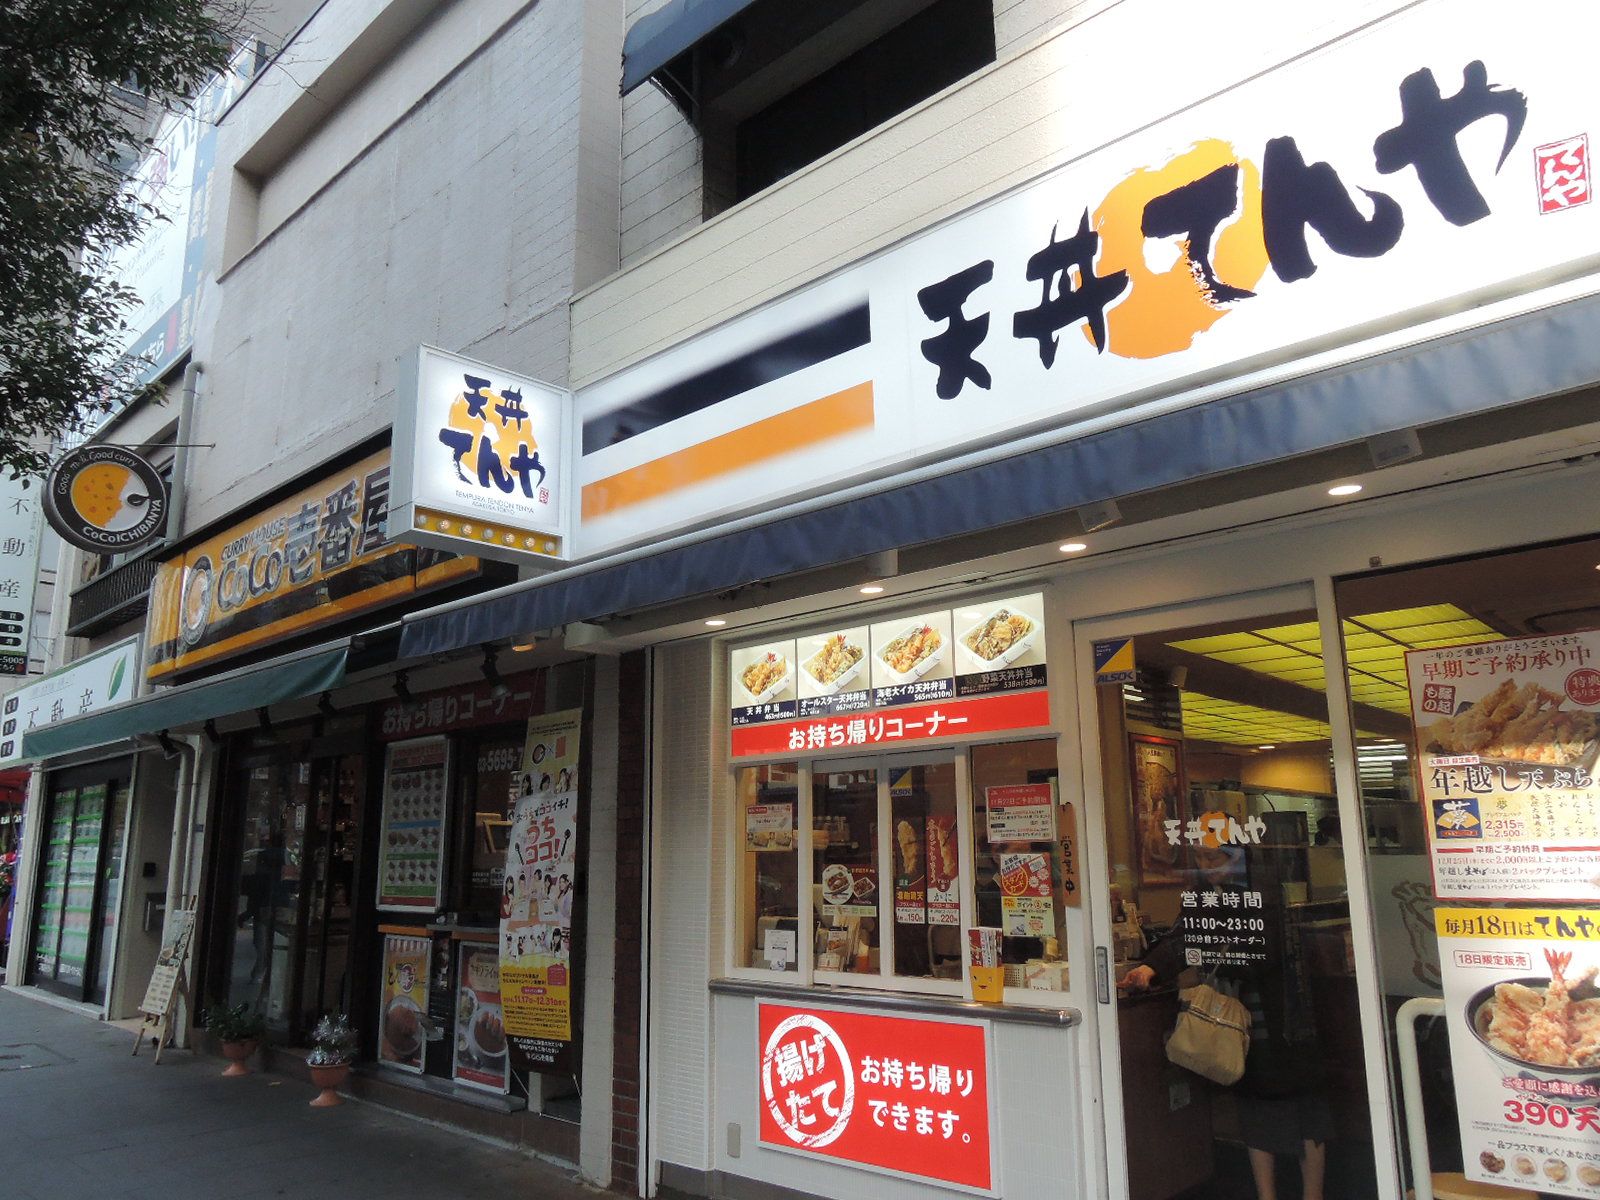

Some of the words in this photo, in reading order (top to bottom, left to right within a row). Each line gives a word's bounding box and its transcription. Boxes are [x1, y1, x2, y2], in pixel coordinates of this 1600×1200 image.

[1543, 144, 1586, 211] てんや
[463, 373, 529, 431] 天丼
[114, 453, 138, 467] curry
[439, 428, 546, 499] てんや
[83, 499, 162, 543] CoCoICHIBANYA
[221, 536, 249, 561] CURRY
[250, 515, 286, 548] HOUSE
[1096, 671, 1134, 684] ALSOK
[1422, 645, 1590, 681] 早期ご予約承り中
[801, 691, 867, 709] オールスター天丼弁当
[876, 680, 947, 698] 海老大イカ天丼弁当
[746, 703, 780, 716] 天丼弁当
[788, 710, 968, 750] お持ち帰りコーナー
[1430, 765, 1593, 796] 年越し天ぷら
[527, 815, 557, 845] うち
[1163, 815, 1267, 846] 天丼てんや
[1443, 800, 1471, 830] 夢
[525, 838, 561, 865] ココ!
[1180, 890, 1263, 909] 営業時間
[1183, 917, 1264, 931] 11:00～23:00
[1184, 933, 1266, 946] (20分前ラストオーダー)
[1458, 954, 1527, 967] 18日限定販売
[774, 1033, 827, 1088] 揚げ
[860, 1055, 973, 1097] お持ち帰り
[785, 1080, 842, 1130] たて
[868, 1099, 971, 1144] できます。
